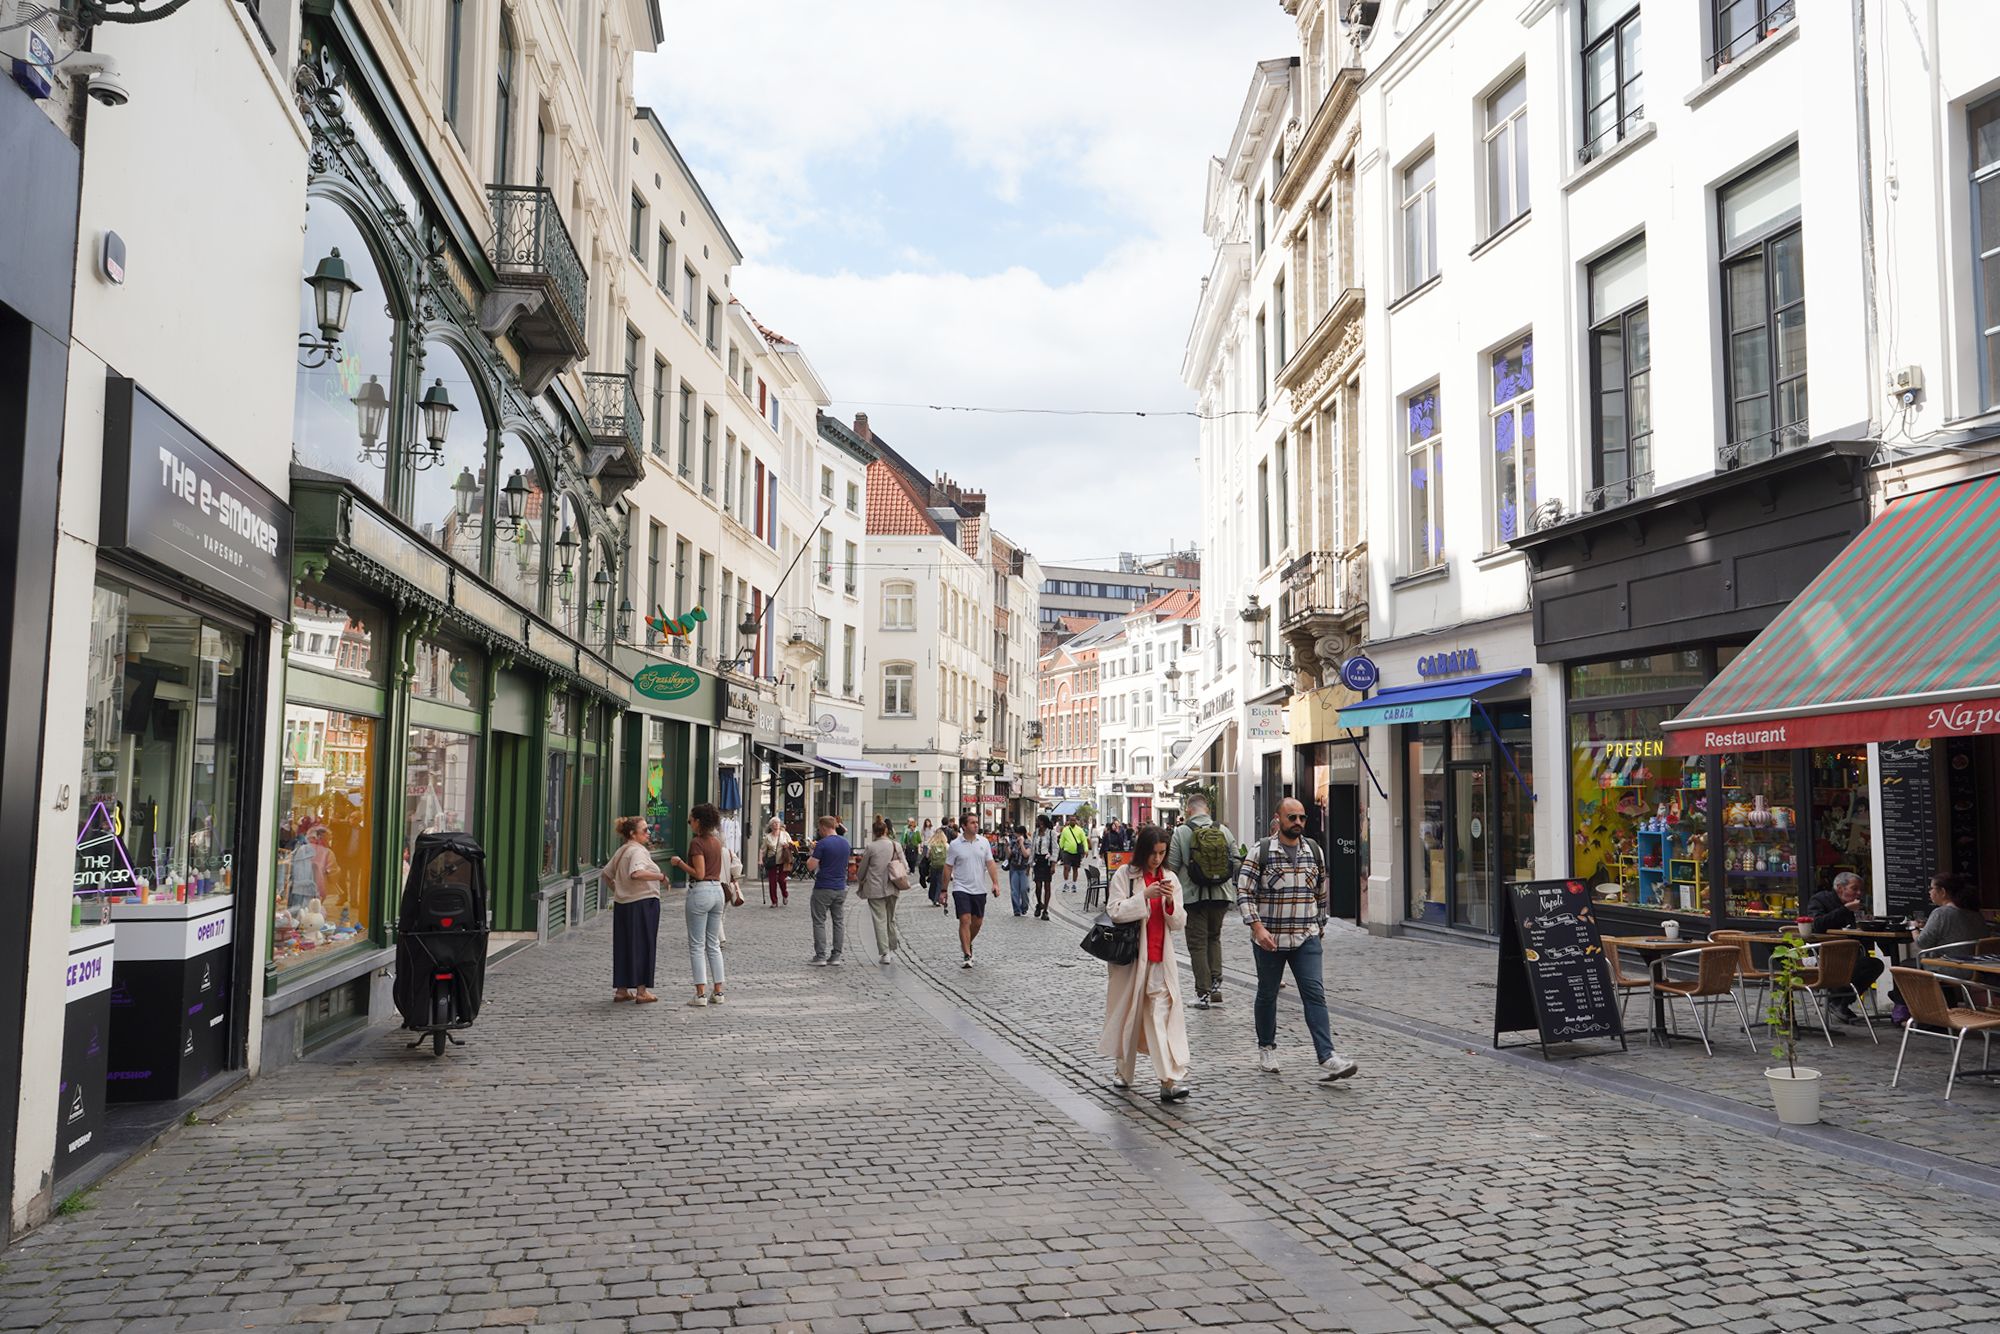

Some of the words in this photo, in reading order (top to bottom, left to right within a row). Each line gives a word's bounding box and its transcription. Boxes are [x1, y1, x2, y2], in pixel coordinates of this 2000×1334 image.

[203, 533, 243, 567] VAPESHOP
[1251, 707, 1278, 717] Eight
[1260, 719, 1270, 727] &
[1250, 727, 1280, 736] Three
[1704, 726, 1787, 749] Restaurant
[790, 784, 801, 797] V
[1540, 894, 1563, 912] Napoli
[78, 957, 102, 983] 2014
